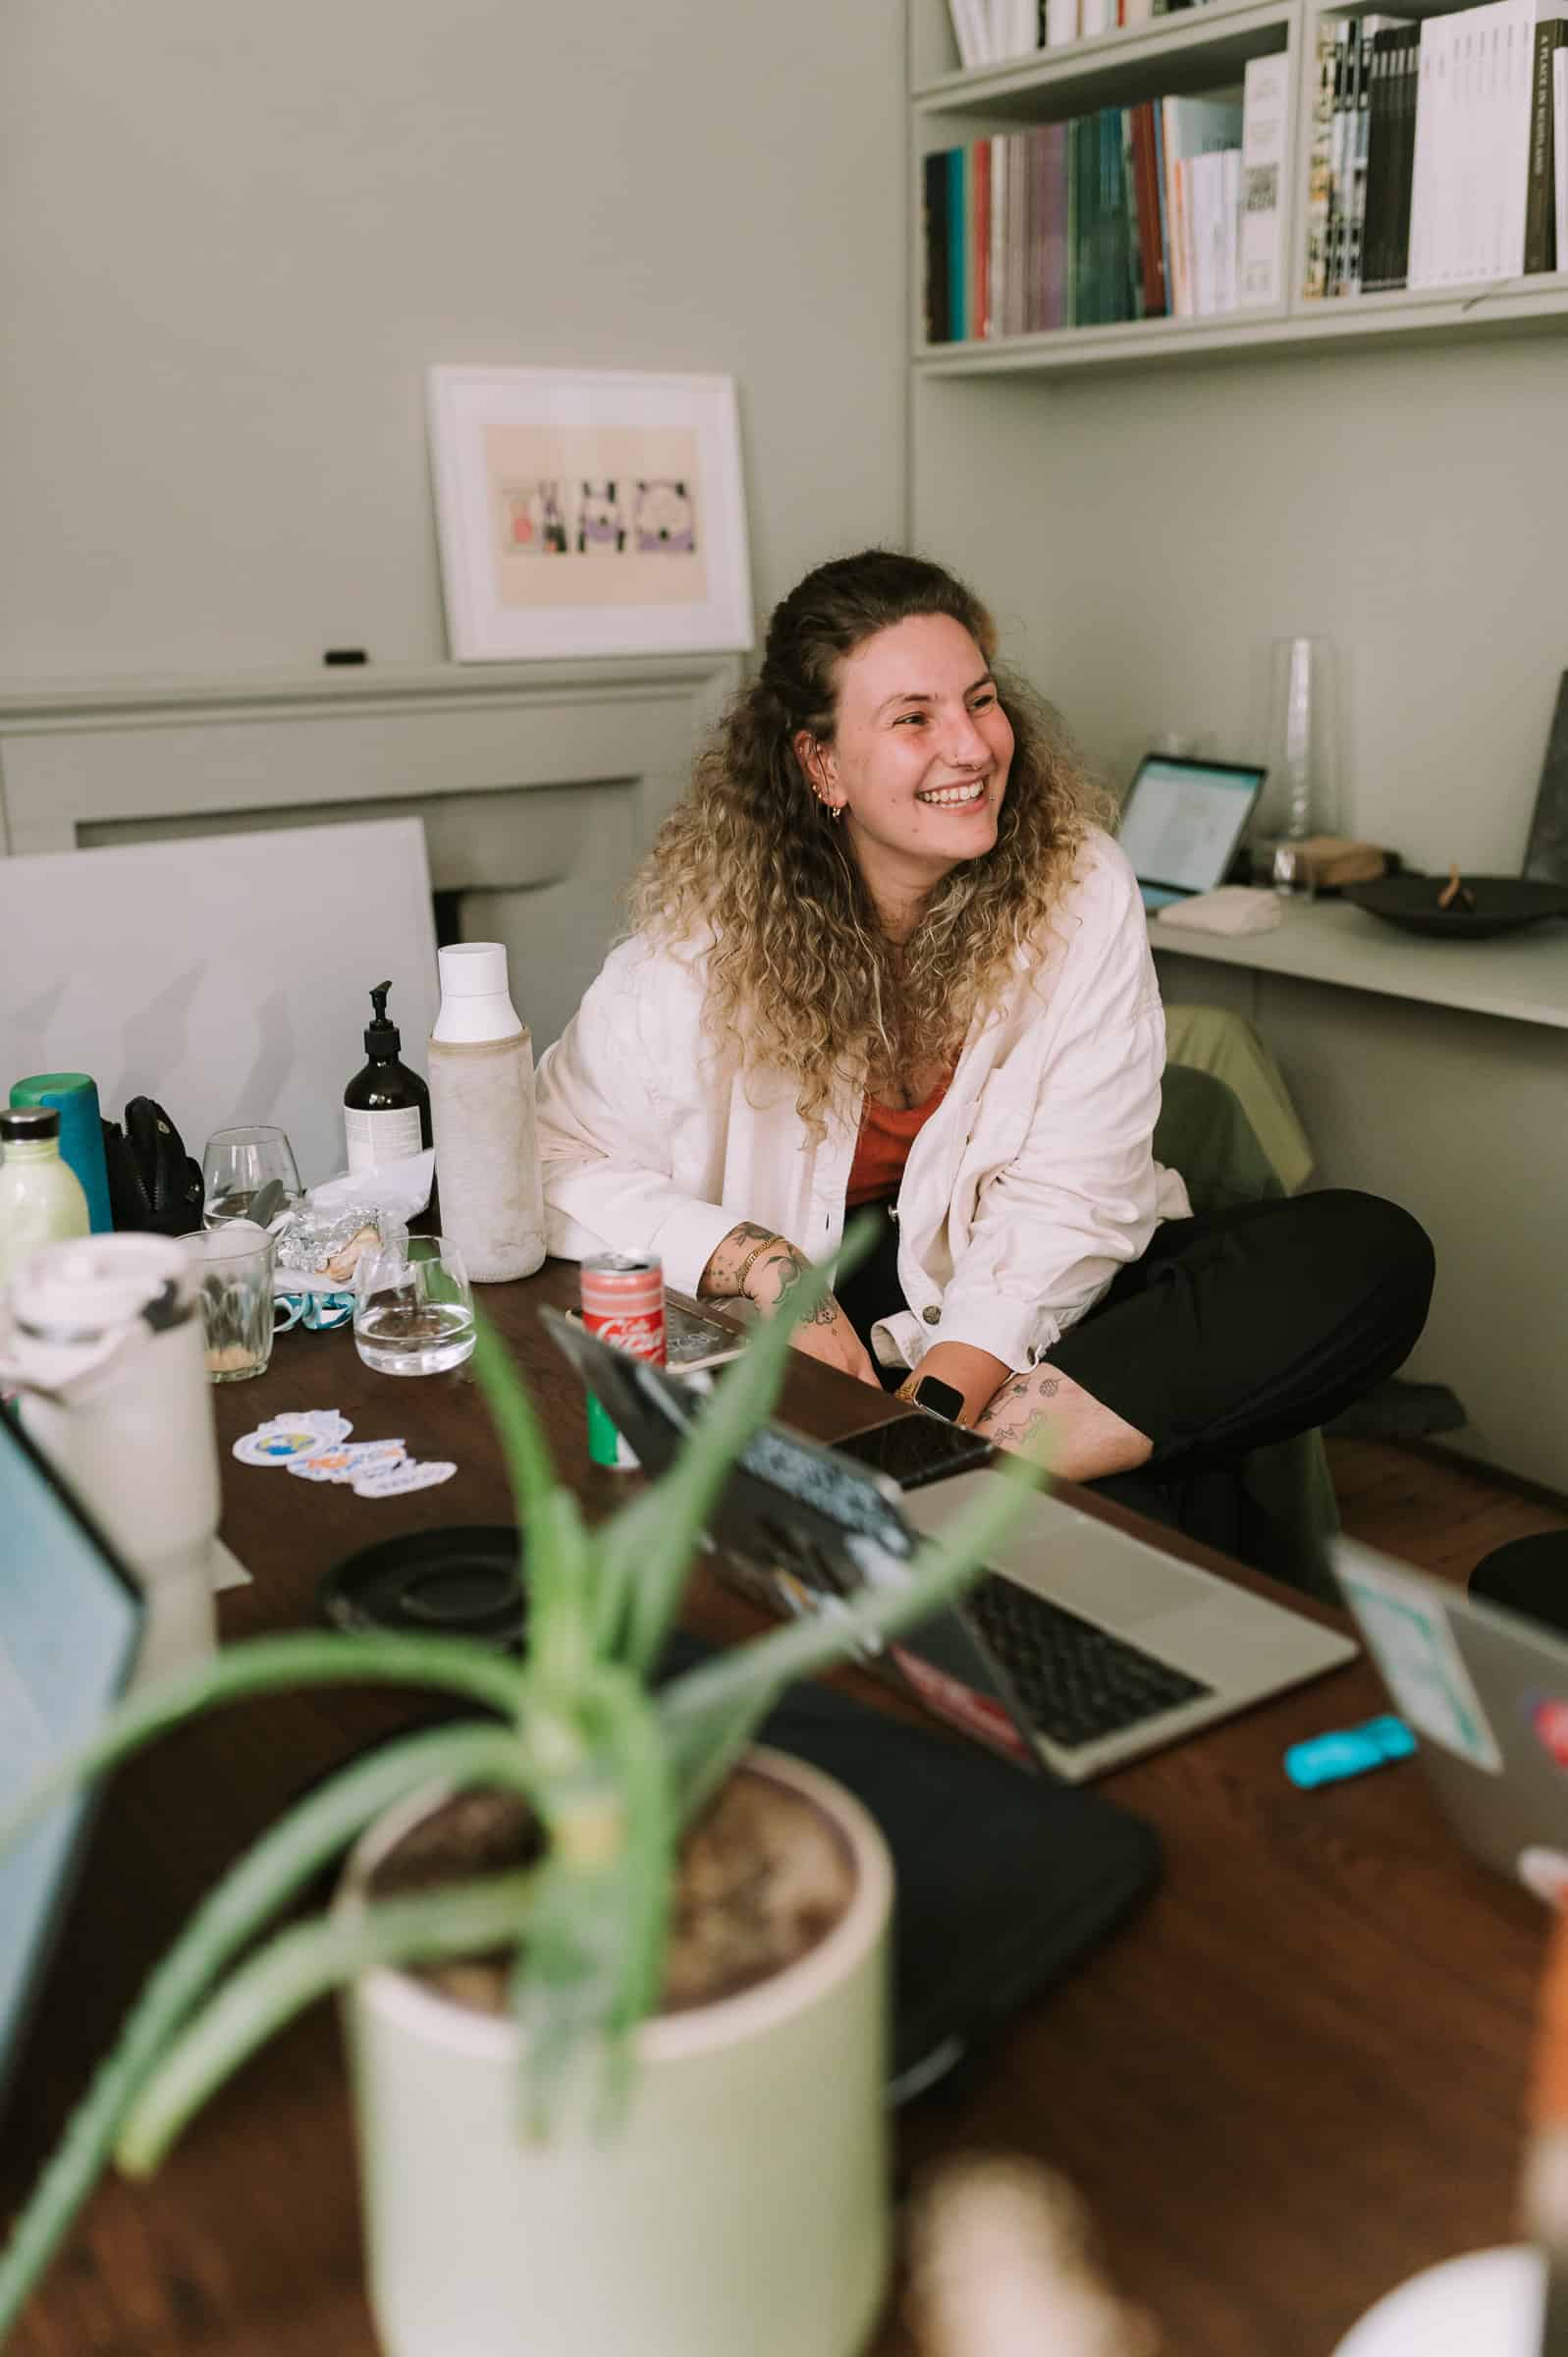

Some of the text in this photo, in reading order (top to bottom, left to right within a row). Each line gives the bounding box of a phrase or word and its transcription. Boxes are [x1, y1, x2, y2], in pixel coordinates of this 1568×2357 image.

[1541, 34, 1548, 45] A
[1539, 46, 1548, 86] PLACE
[1538, 89, 1547, 104] IN
